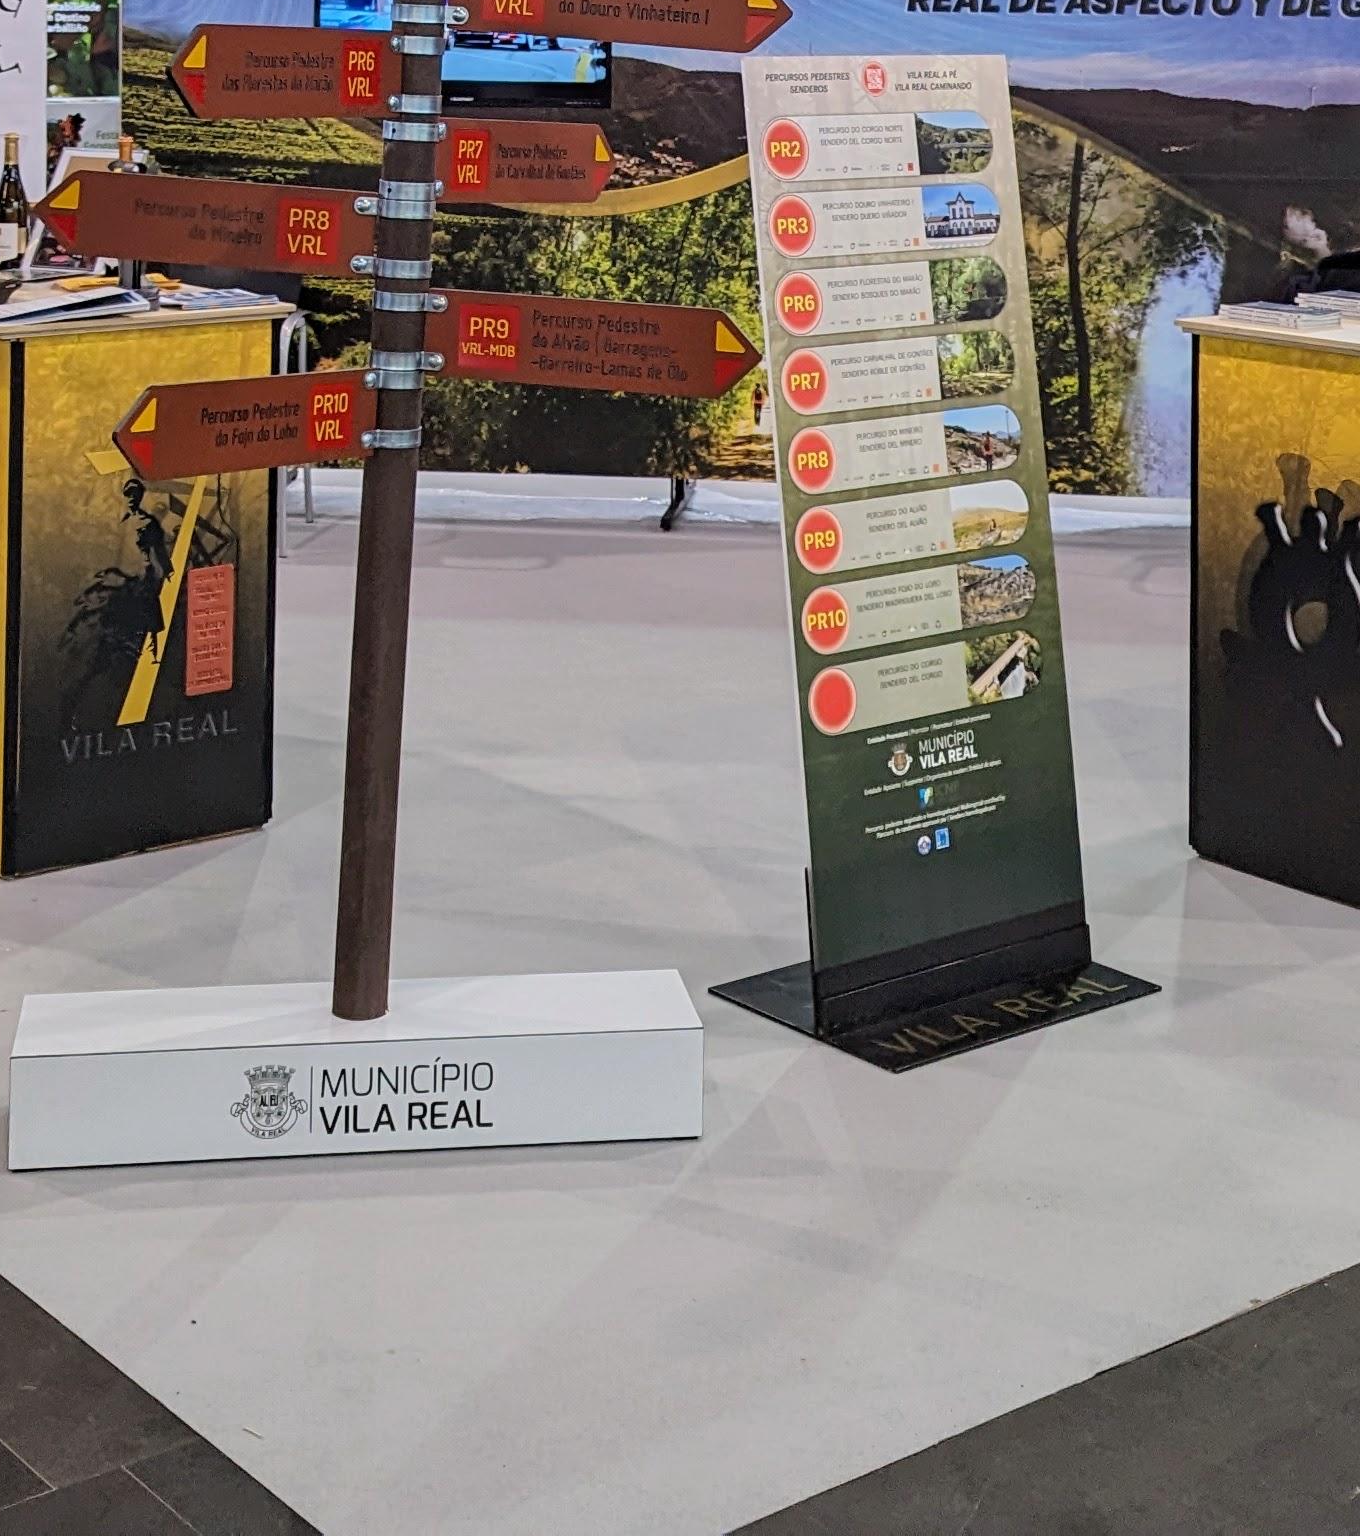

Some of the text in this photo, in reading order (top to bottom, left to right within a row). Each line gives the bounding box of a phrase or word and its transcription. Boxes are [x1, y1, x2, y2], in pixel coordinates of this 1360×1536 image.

[581, 0, 620, 17] Douro
[627, 3, 699, 23] Vinhateiro
[349, 51, 375, 71] PR6
[766, 72, 849, 81] PERCURSOS PEDESTRES
[907, 71, 922, 79] VILA
[950, 69, 957, 78] PÉ
[348, 77, 373, 97] VRL
[791, 85, 827, 93] SENDEROS
[930, 82, 972, 90] CAMINANDO
[458, 140, 483, 159] PR7
[771, 141, 801, 158] PR2
[458, 165, 480, 183] VRL
[290, 208, 330, 230] PR8
[778, 217, 808, 234] PR3
[287, 233, 327, 256] VRL
[784, 295, 815, 312] PR6
[470, 316, 509, 339] PR9
[533, 310, 660, 335] Percurso Pedestre
[462, 342, 515, 358] VRL-MDB
[552, 333, 589, 352] Alvão
[791, 372, 820, 391] PR7
[201, 403, 300, 425] Percurso Pedestre
[313, 393, 348, 415] PR10
[315, 420, 343, 441] VRL
[798, 451, 828, 471] PR8
[804, 530, 835, 550] PR9
[808, 609, 846, 631] PR10
[60, 709, 240, 763] VILA REAL
[919, 730, 974, 754] MUNICÍPIO
[919, 745, 978, 769] VILA REAL
[875, 1014, 1000, 1053] VILA
[321, 1056, 493, 1098] MUNICÍPIO
[320, 1099, 493, 1134] VILA REAL
